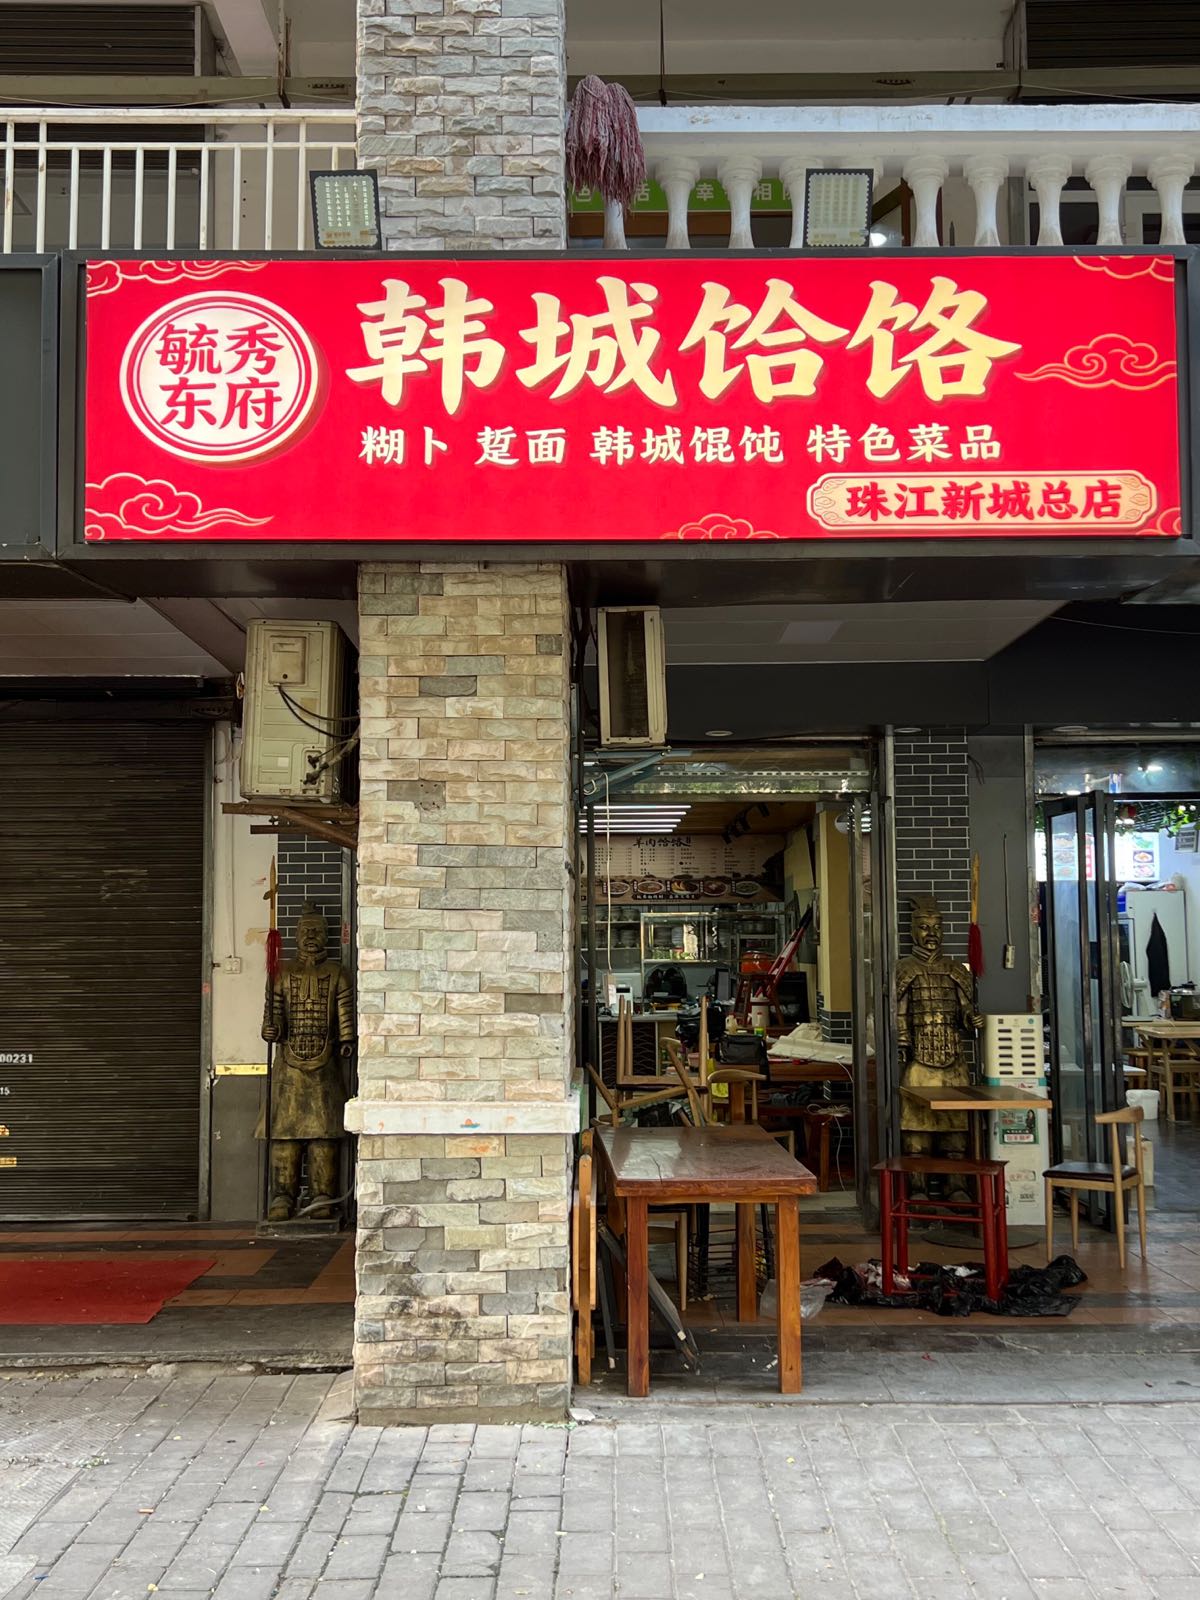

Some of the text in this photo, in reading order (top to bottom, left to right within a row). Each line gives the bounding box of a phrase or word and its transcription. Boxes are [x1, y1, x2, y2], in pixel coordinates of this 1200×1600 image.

[155, 321, 285, 376] 毓秀
[345, 276, 1023, 415] 韩城饸饹
[158, 376, 283, 430] 东府
[358, 423, 1001, 466] 糊卜 踅面 韩城馄饨 特色菜品
[845, 478, 1122, 522] 珠江新城总店
